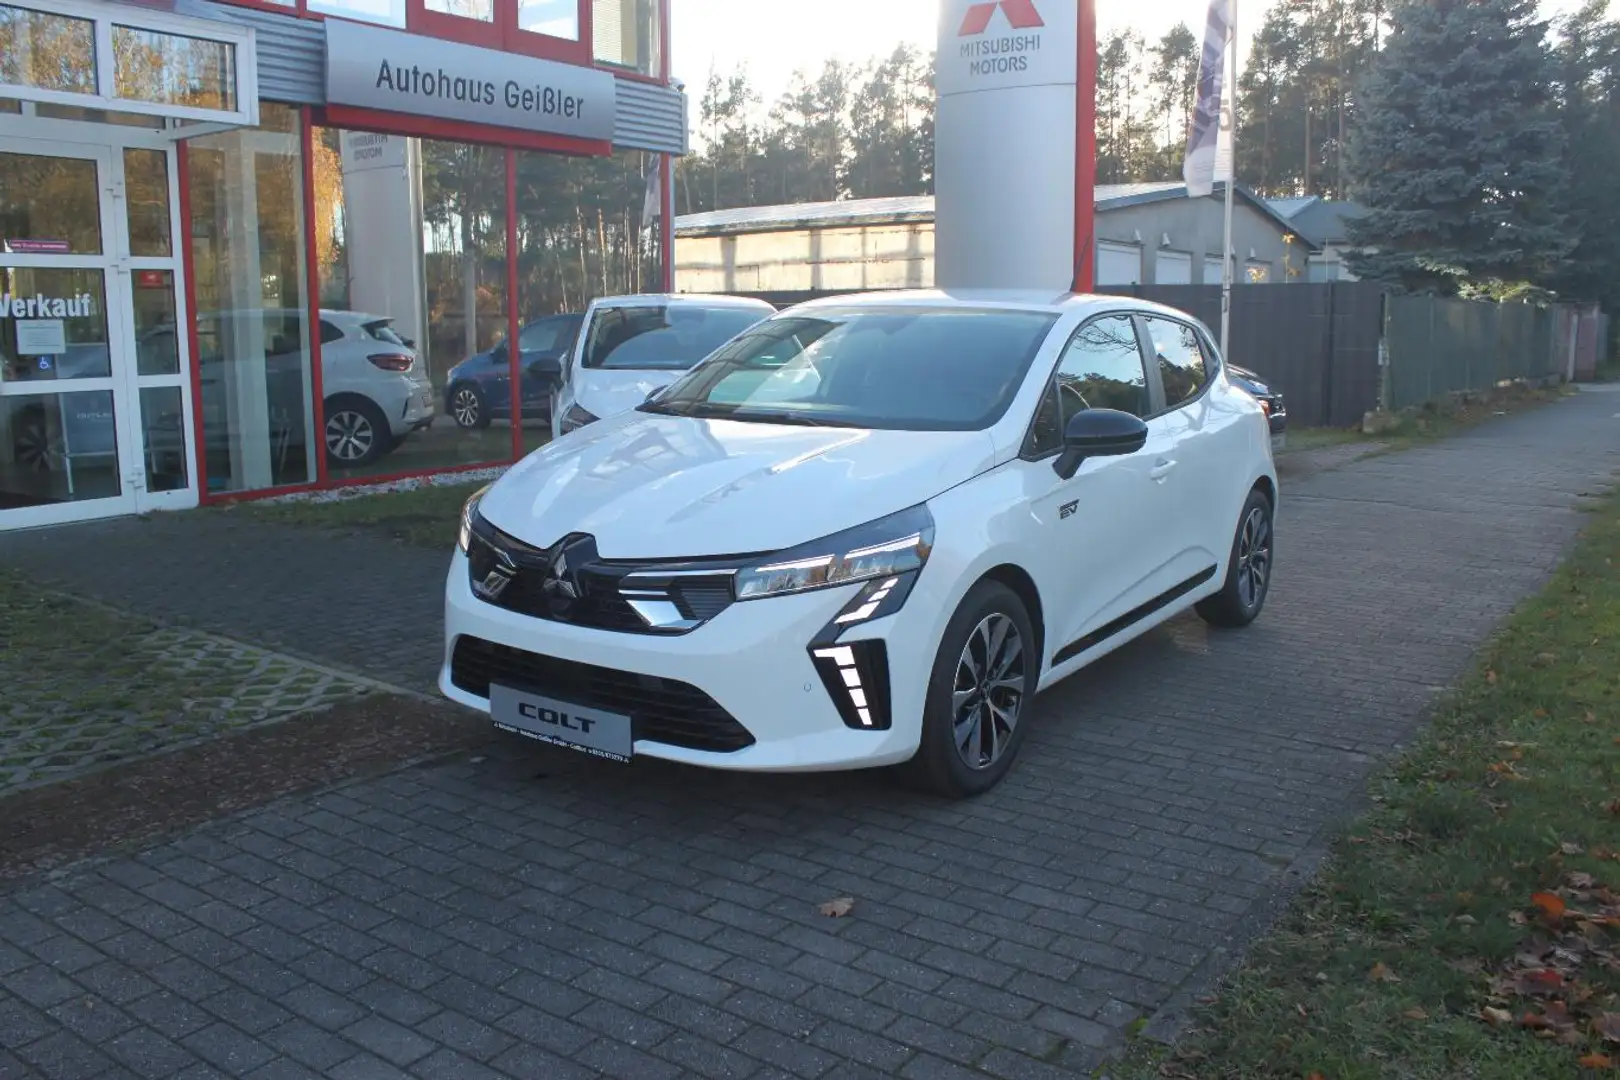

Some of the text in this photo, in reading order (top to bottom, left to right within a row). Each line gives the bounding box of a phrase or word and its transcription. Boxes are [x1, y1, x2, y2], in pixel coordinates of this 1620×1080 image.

[959, 34, 1041, 58] MITSUBISHI
[968, 56, 1028, 77] MOTORS
[376, 58, 584, 119] Autohaus Geißler
[0, 292, 91, 318] Verkauf
[518, 702, 596, 734] COLT
